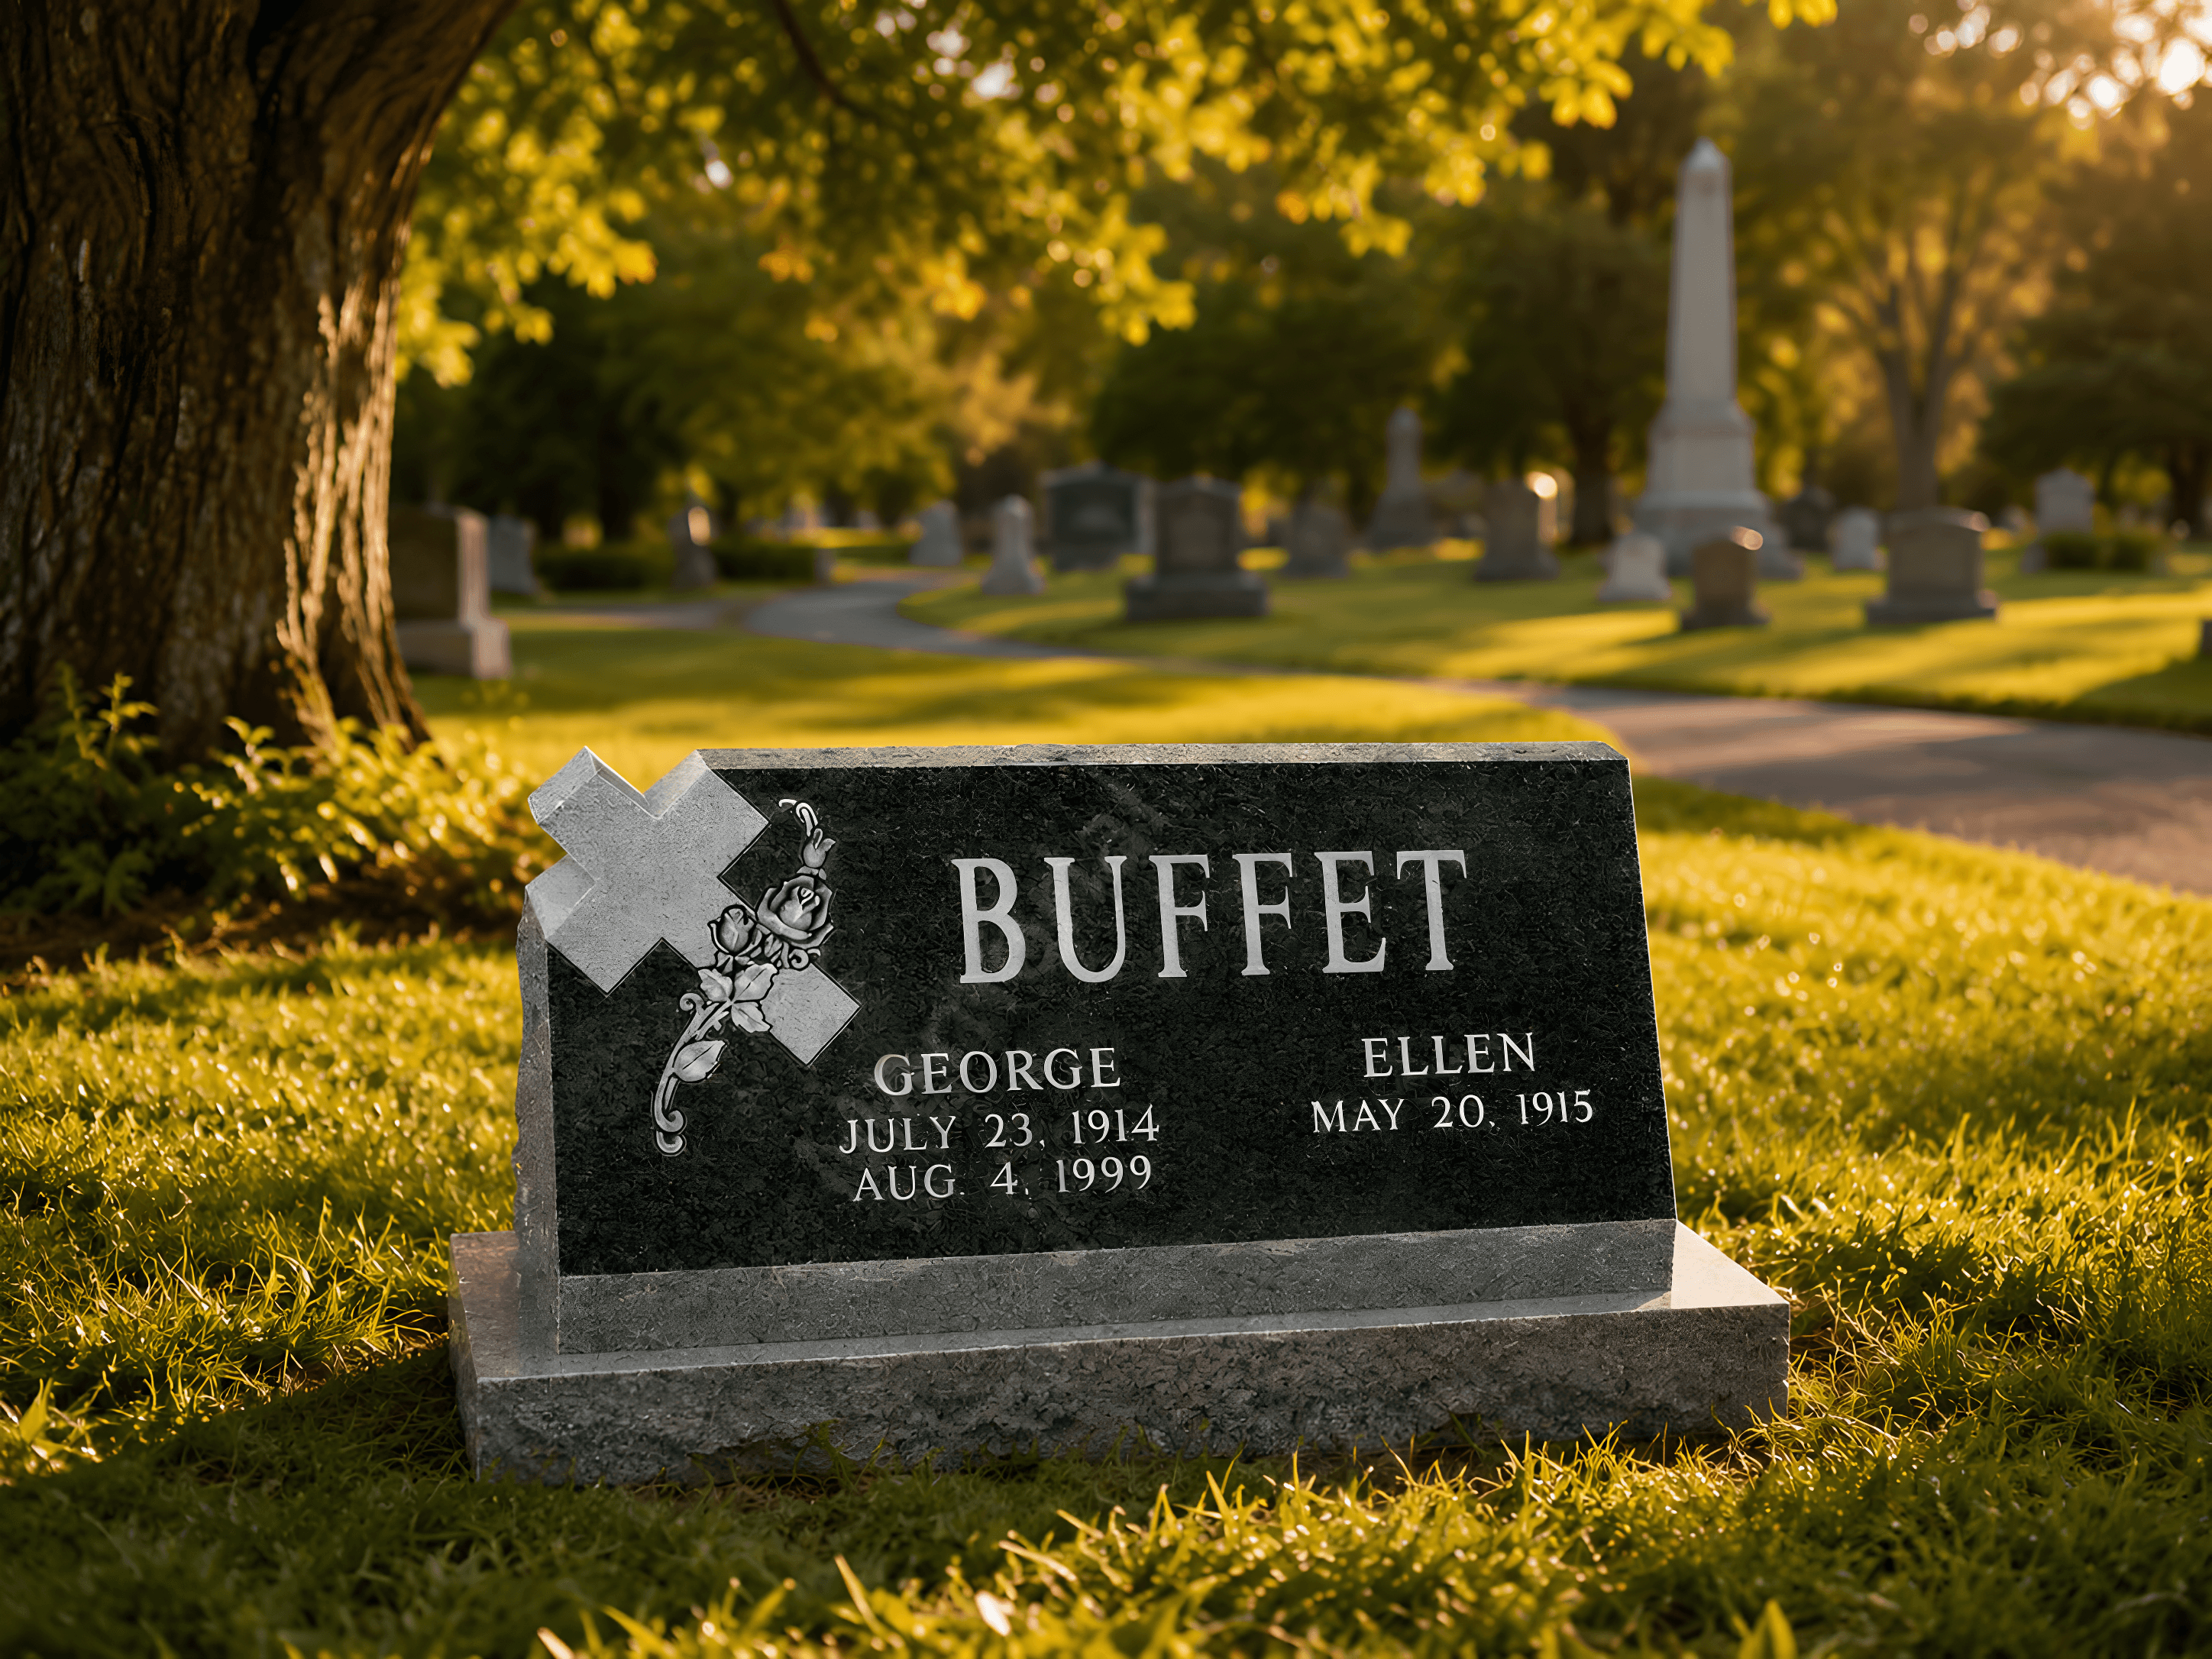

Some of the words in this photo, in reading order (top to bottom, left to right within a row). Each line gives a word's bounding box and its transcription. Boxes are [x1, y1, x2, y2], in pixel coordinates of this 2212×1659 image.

[950, 849, 1467, 983] BUFFET
[874, 1047, 1121, 1095] GEORGE
[1361, 1033, 1535, 1078] ELLEN
[839, 1115, 956, 1154] JULY
[984, 1113, 1046, 1151] 23,
[1072, 1104, 1159, 1145] 1914
[1311, 1098, 1405, 1133] MAY
[1515, 1089, 1593, 1126] 1915
[852, 1163, 965, 1202] AUG.
[1056, 1155, 1151, 1193] 1999
